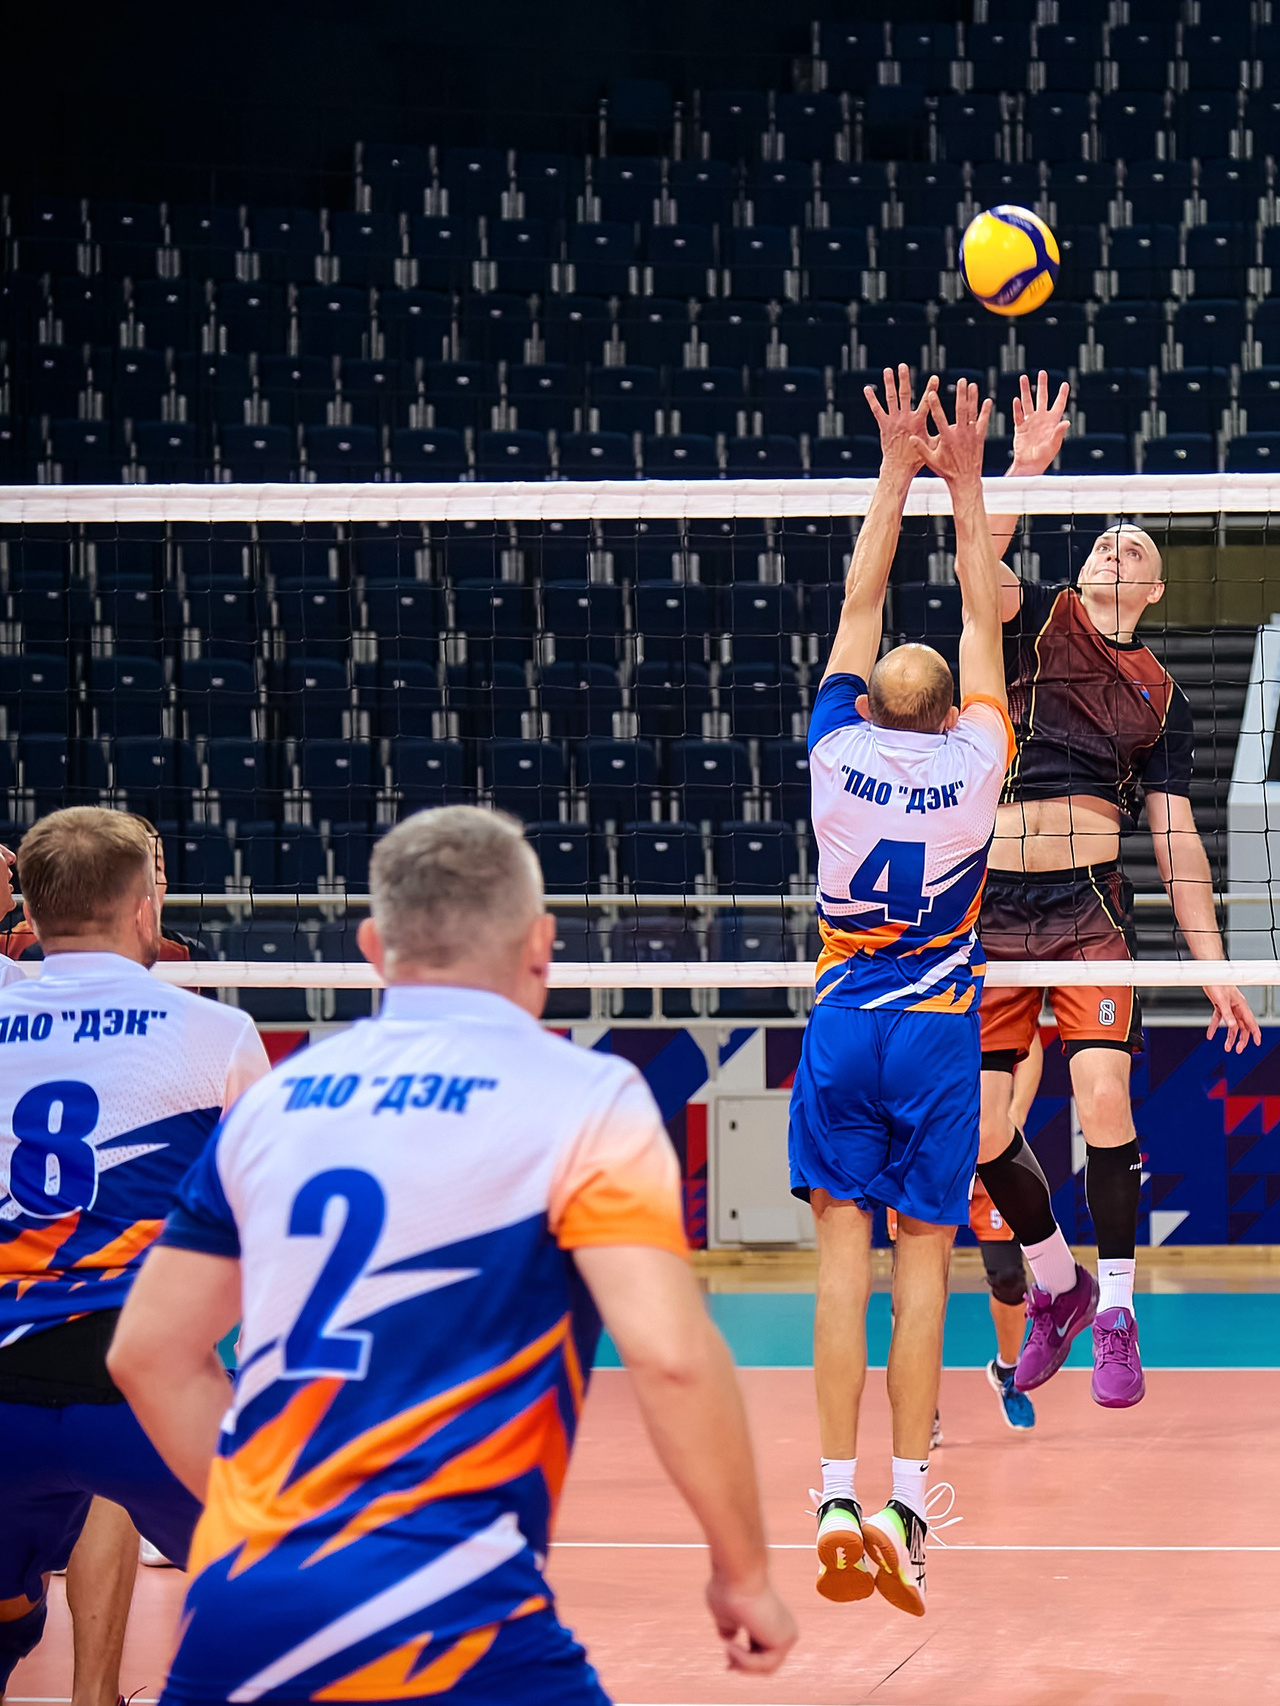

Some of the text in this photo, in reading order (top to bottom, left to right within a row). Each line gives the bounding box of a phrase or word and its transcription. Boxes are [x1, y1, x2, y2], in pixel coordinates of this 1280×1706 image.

[841, 764, 965, 815] "ПАО "ДЭК"
[849, 838, 934, 927] 4
[61, 1008, 168, 1043] "ДЭК"
[9, 1079, 99, 1219] 8
[989, 1209, 1003, 1230] 5
[282, 1166, 386, 1380] 2
